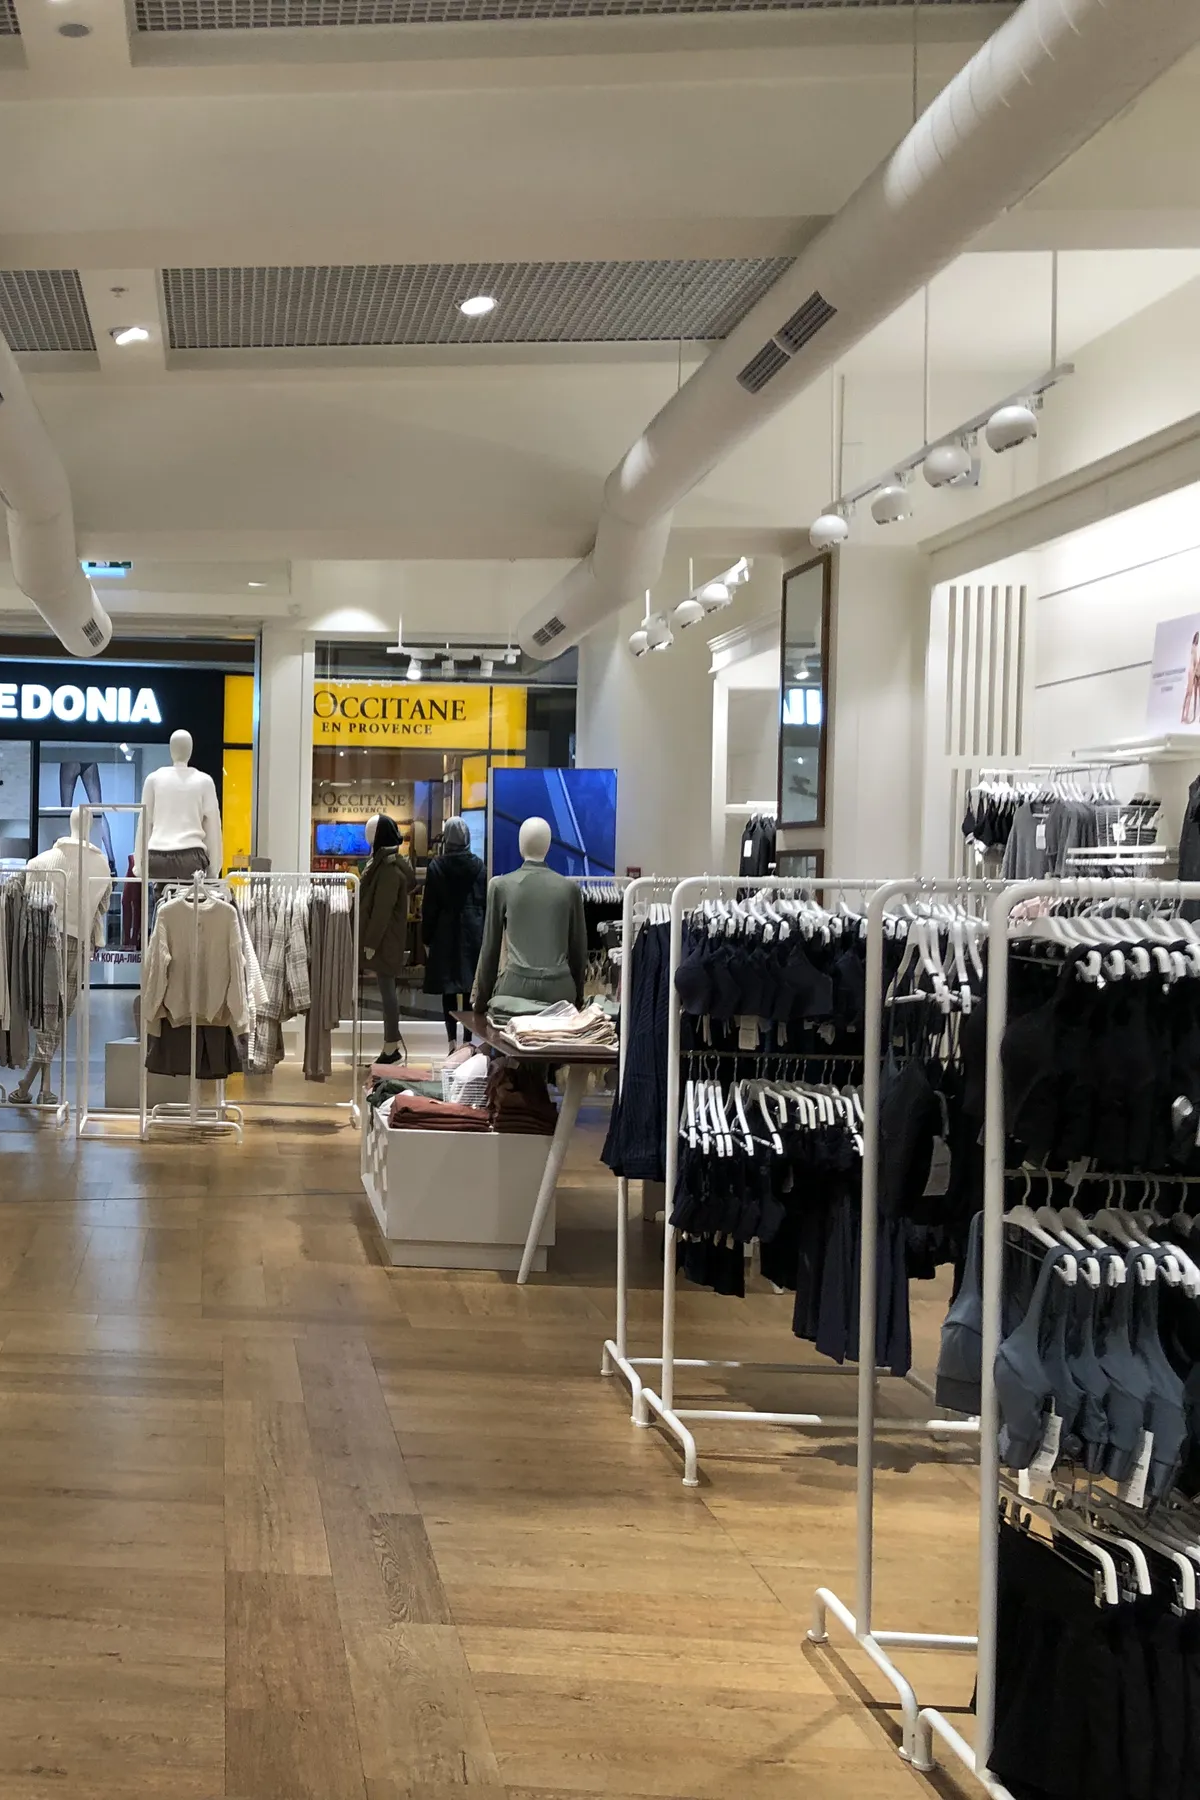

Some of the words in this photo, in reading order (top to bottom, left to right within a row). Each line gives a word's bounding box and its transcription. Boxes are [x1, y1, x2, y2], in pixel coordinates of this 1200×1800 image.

[322, 722, 341, 733] EN
[349, 723, 433, 735] PROVENCE
[102, 954, 142, 964] КОГДА-ЛИБ
